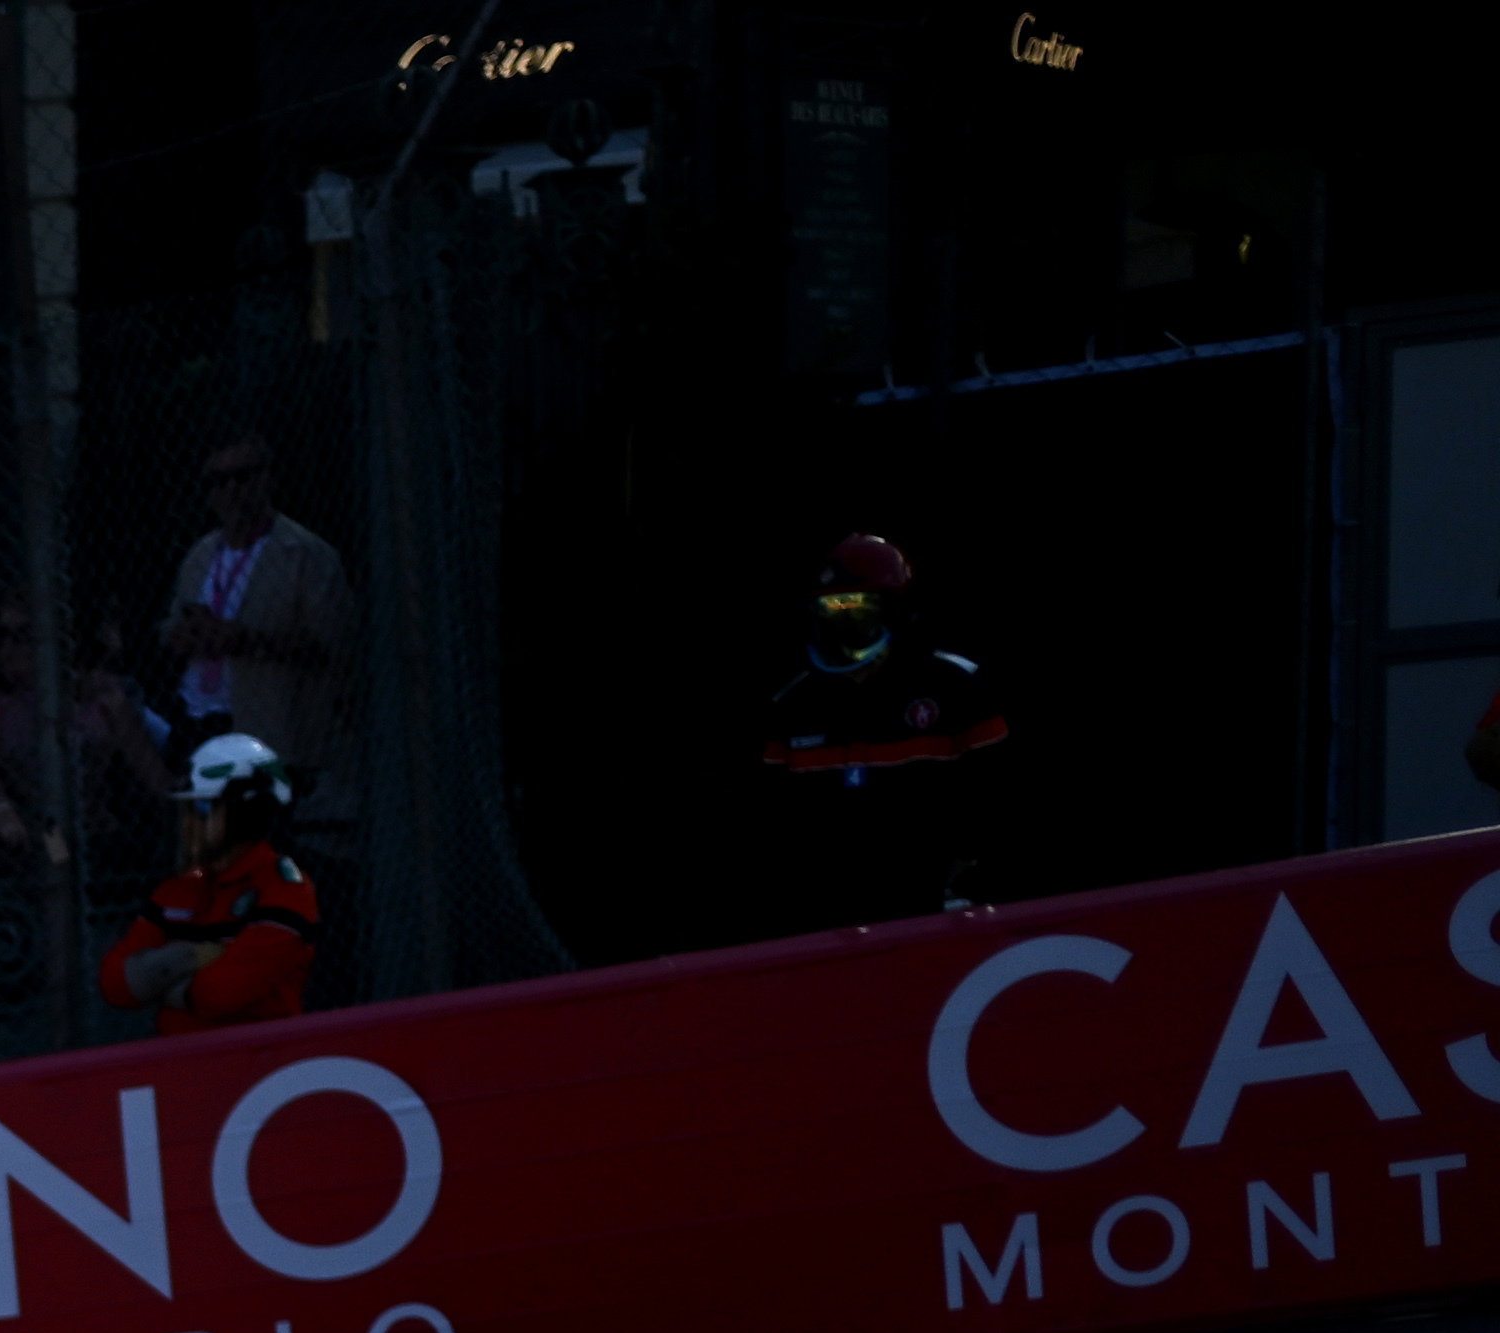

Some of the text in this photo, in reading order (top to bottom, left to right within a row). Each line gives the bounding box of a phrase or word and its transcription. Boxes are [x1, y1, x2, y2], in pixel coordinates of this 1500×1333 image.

[397, 33, 577, 91] Ctier
[1011, 12, 1083, 71] Cartier
[941, 1153, 1467, 1310] MONT
